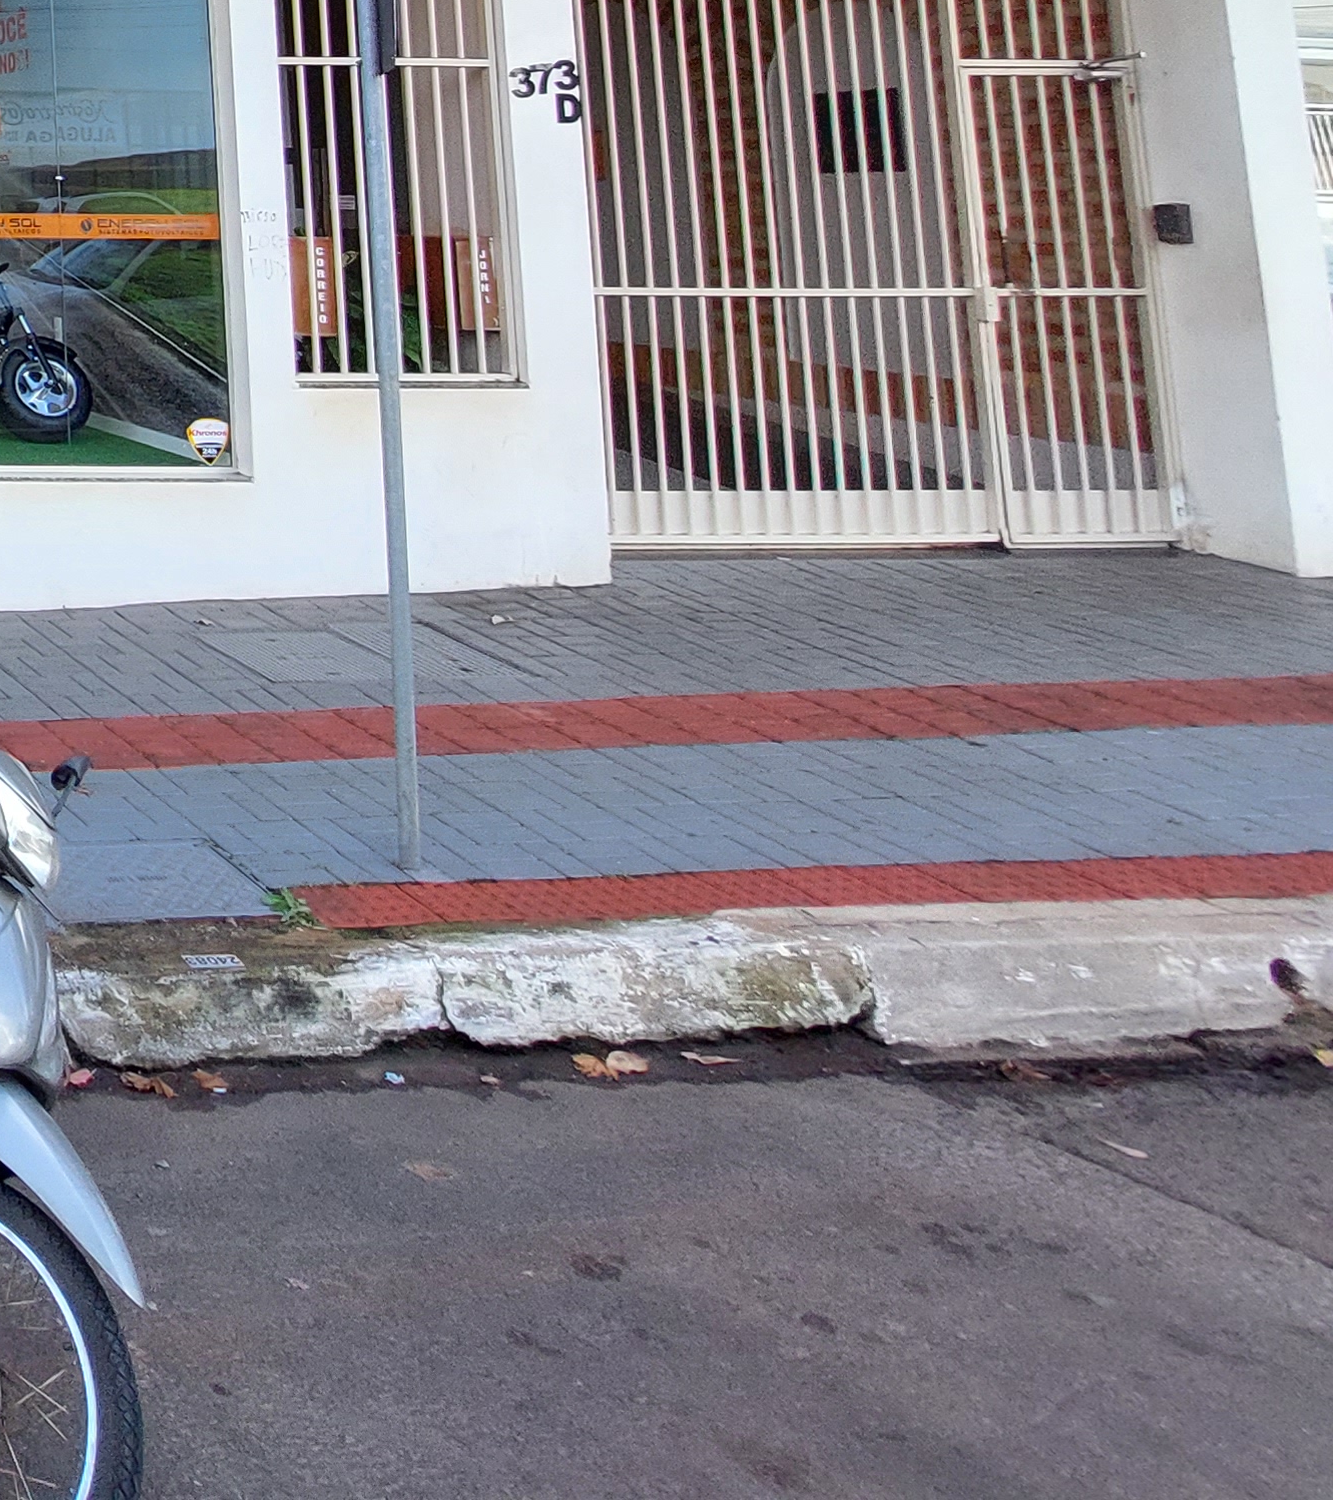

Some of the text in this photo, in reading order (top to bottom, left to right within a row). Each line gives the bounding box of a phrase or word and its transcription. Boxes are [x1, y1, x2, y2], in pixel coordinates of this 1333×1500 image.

[509, 60, 579, 98] 373
[555, 93, 582, 123] D
[9, 218, 41, 228] SOL
[97, 218, 170, 229] ENERGY
[315, 247, 328, 324] CORREIO
